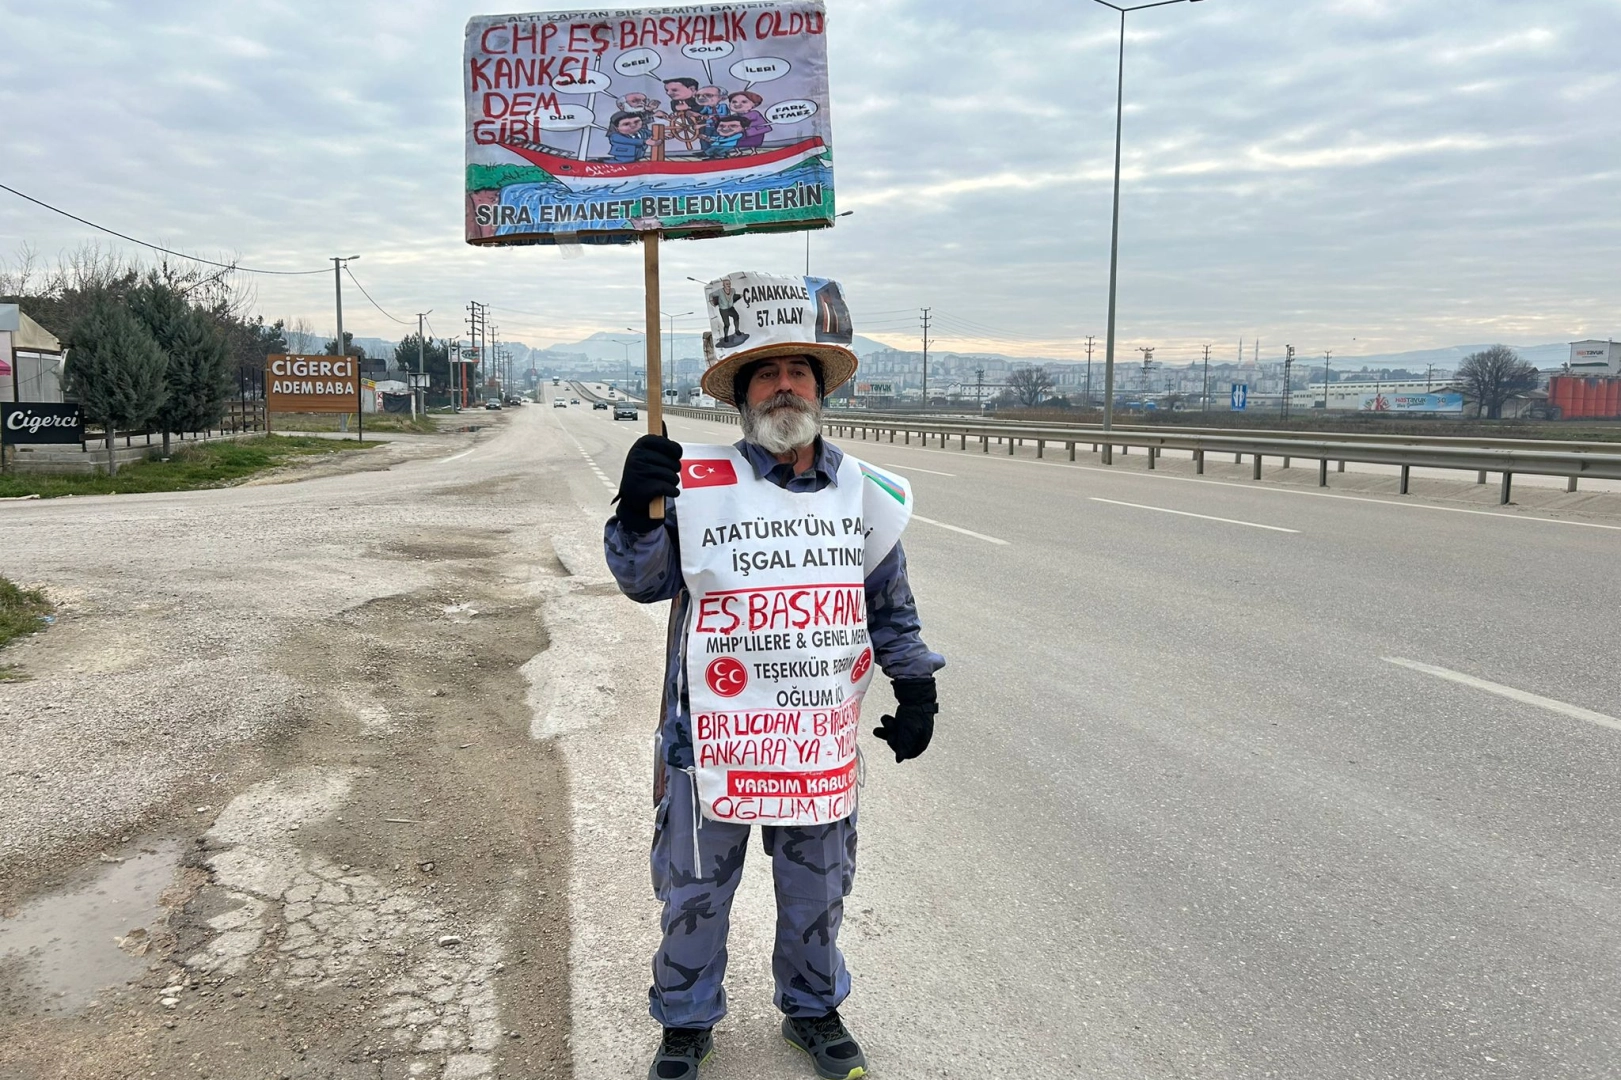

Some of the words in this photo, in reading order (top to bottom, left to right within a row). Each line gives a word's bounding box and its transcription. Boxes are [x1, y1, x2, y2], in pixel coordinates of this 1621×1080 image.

[508, 15, 540, 23] ALTI
[547, 11, 609, 21] KAPTAN
[481, 23, 558, 54] CHP
[619, 11, 748, 50] BAŞKALIK
[755, 10, 824, 40] OLDU
[622, 57, 649, 67] GERİ
[746, 65, 776, 73] İLERİ
[483, 92, 561, 119] DEM
[772, 110, 811, 120] ETMEZ
[775, 103, 807, 112] FARK
[476, 204, 531, 226] SIRA
[540, 199, 635, 223] EMANET
[641, 181, 823, 218] BELEDİYELERİN
[743, 285, 809, 308] ÇANAKKALE
[757, 309, 774, 328] 57.
[777, 307, 803, 325] ALAY
[272, 356, 352, 377] CİĞERCİ
[273, 380, 313, 394] ADEM
[316, 381, 354, 394] BABA
[7, 409, 79, 434] Cigerci
[702, 513, 836, 547] ATATÜRK'ÜN
[732, 548, 796, 576] İŞGAL
[706, 631, 791, 653] MHP'LİLERE
[796, 632, 807, 649] &
[811, 630, 849, 648] GENEL
[754, 656, 829, 683] TEŞEKKÜR
[776, 685, 833, 707] OĞLUM
[698, 712, 730, 740] BİR
[735, 778, 801, 794] YARDIM
[806, 775, 848, 794] KABUL
